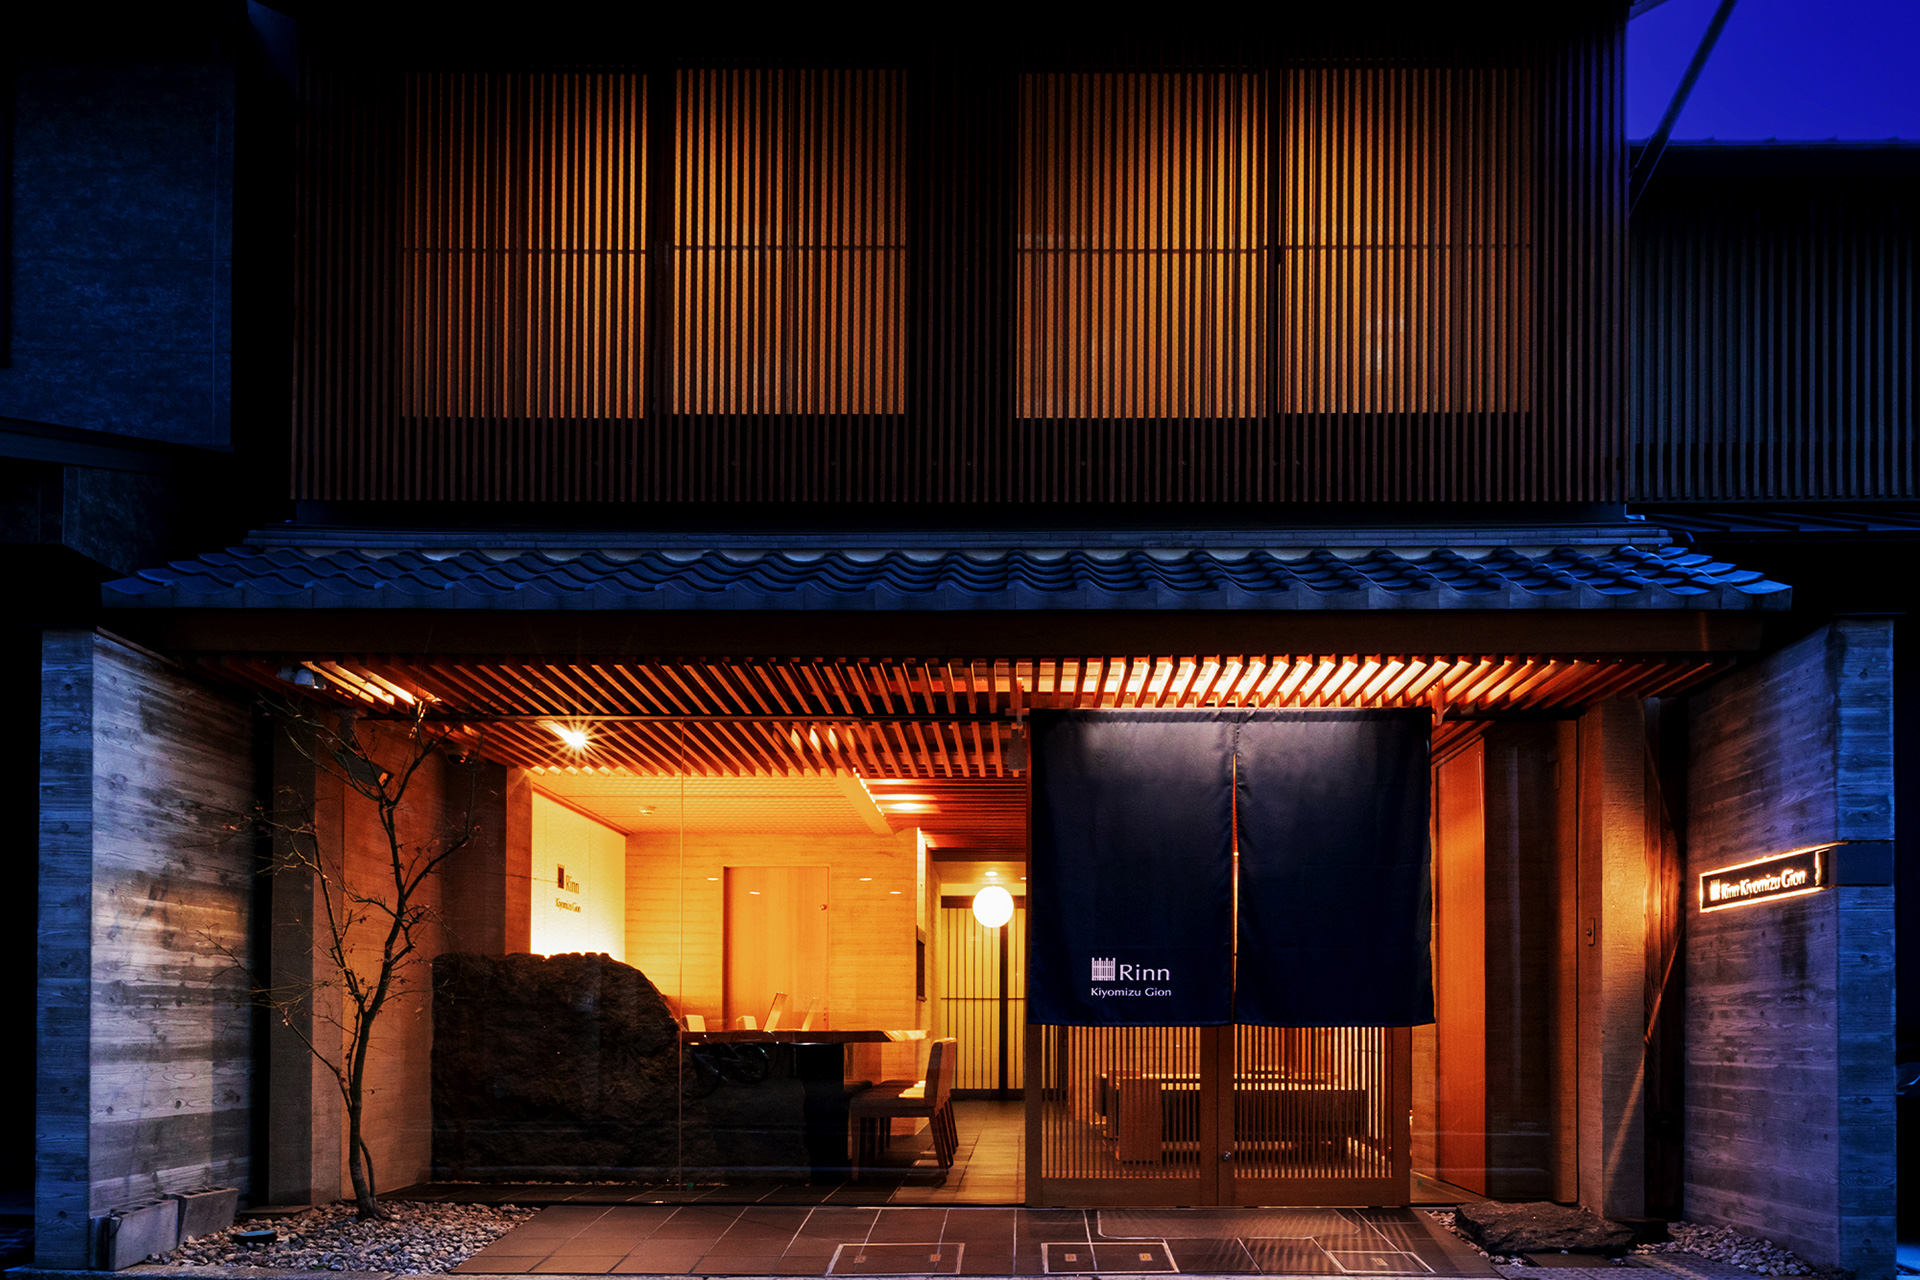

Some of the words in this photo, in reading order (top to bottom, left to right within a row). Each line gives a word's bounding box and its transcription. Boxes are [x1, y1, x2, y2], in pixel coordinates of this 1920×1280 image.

[565, 874, 580, 895] Rinn
[1721, 882, 1739, 900] Rinn
[1740, 874, 1781, 898] Kiyomizu
[1781, 868, 1806, 888] Gion
[1119, 963, 1170, 981] Rinn
[1091, 987, 1141, 999] Kiyomizu
[1144, 987, 1172, 997] Gion
